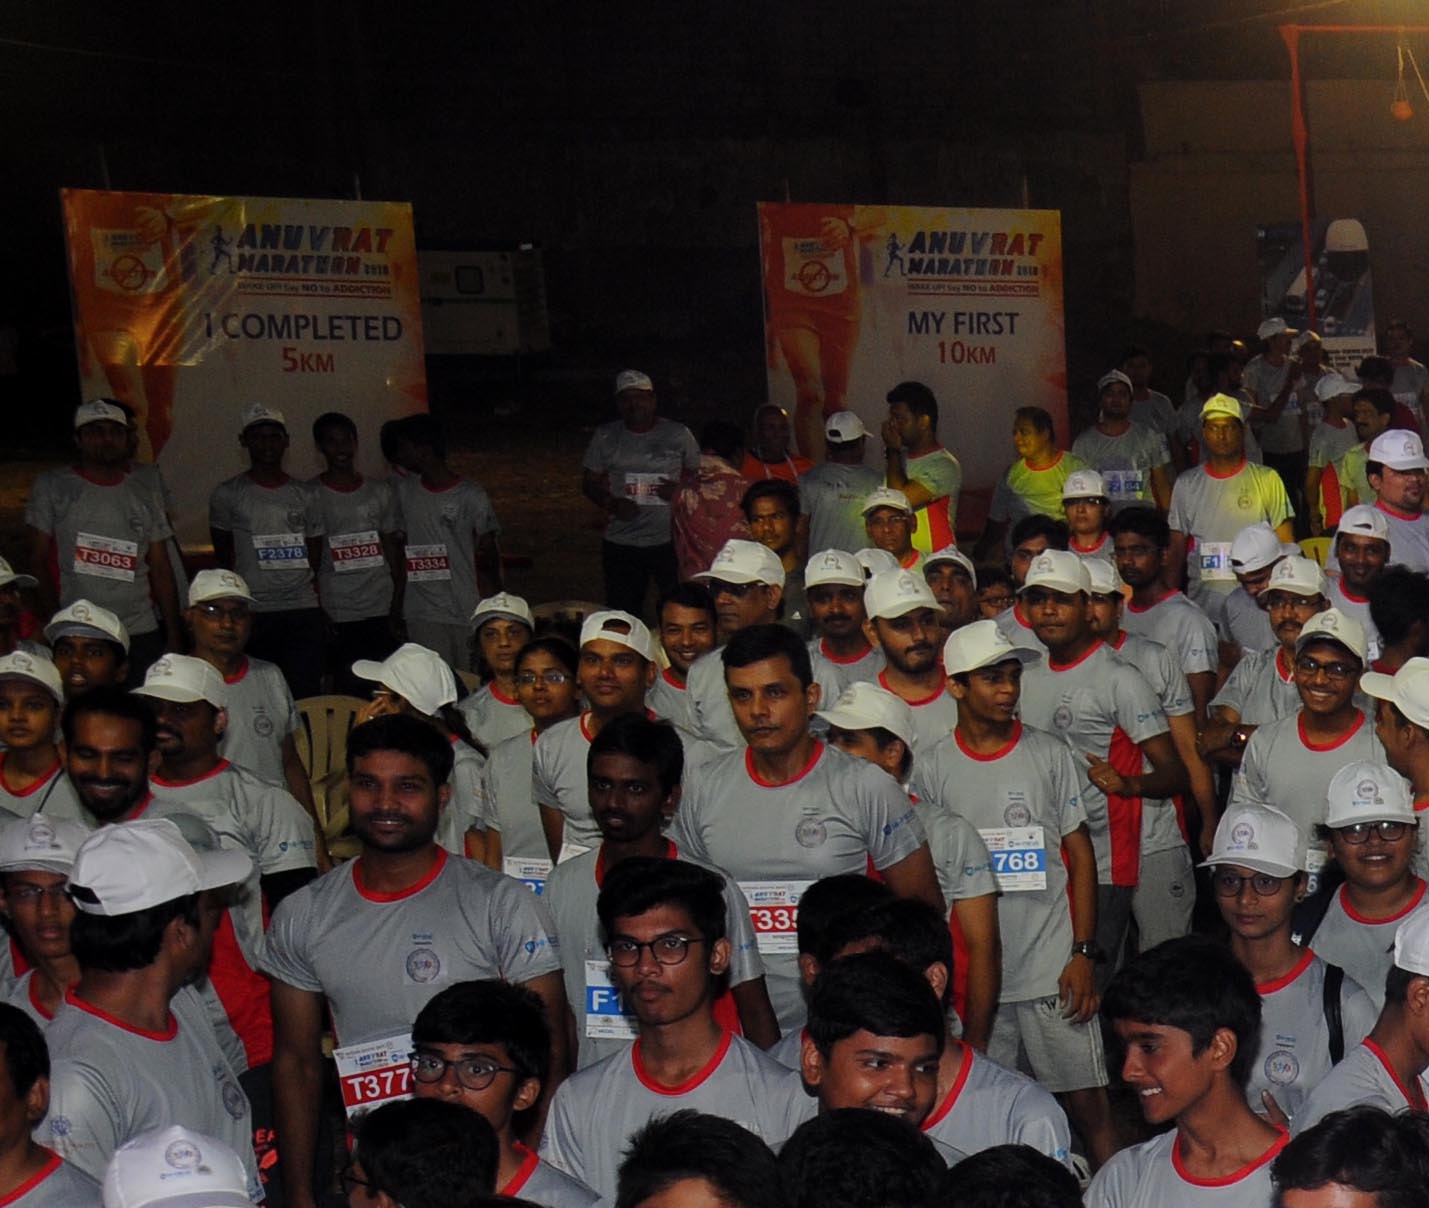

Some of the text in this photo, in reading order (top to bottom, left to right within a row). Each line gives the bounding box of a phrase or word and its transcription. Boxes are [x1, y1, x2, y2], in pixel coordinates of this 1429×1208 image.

[237, 223, 394, 251] ANUVRAT
[907, 231, 1044, 255] ANUVRAT
[237, 252, 361, 276] MARATHON
[907, 257, 1015, 276] MARATHON
[302, 283, 317, 294] NO
[333, 284, 391, 295] ADDICTION
[963, 284, 977, 294] NO
[222, 313, 402, 341] COMPLETED
[908, 311, 1020, 336] MY FIRST
[282, 347, 335, 373] 5KM
[937, 341, 997, 364] 10KM
[79, 548, 132, 570] T3063
[258, 547, 303, 560] F2378
[335, 545, 377, 560] T3328
[409, 558, 447, 570] T3334
[994, 852, 1039, 871] 768
[347, 1067, 414, 1102] T377
